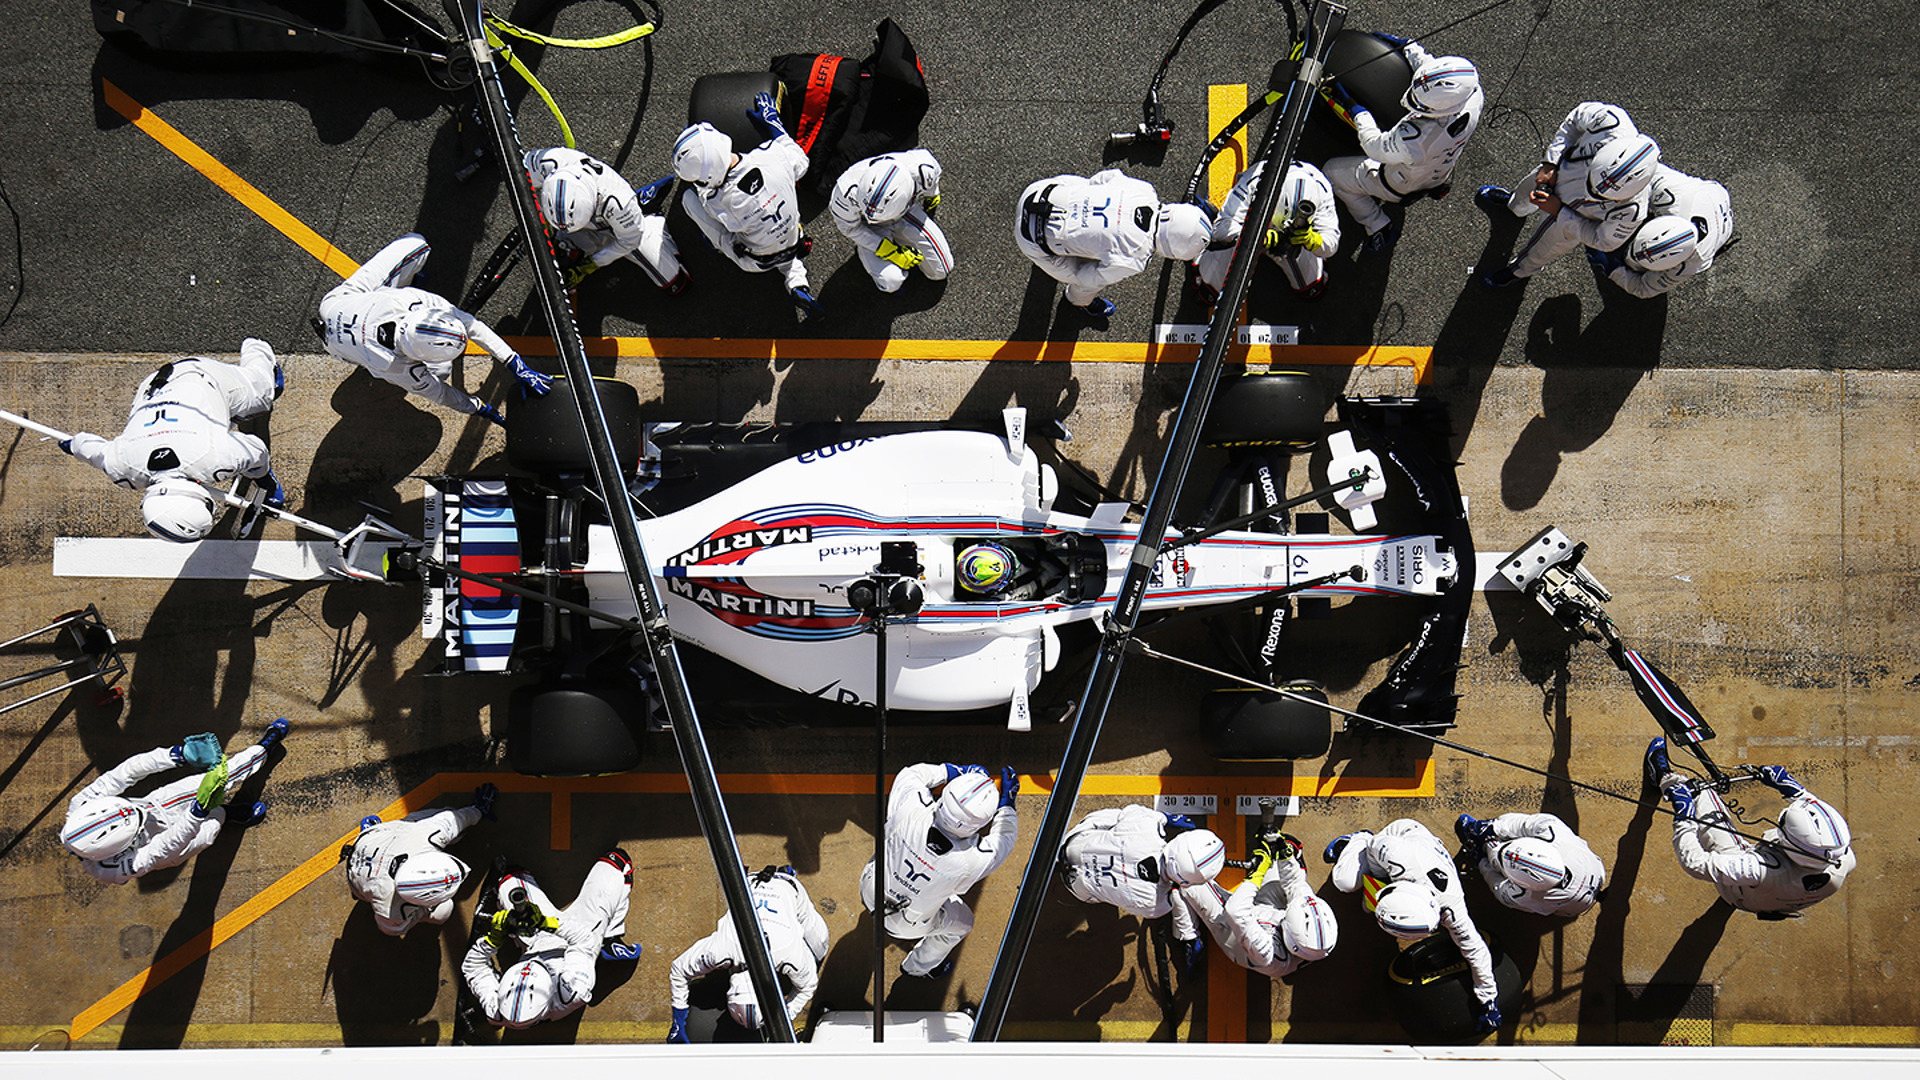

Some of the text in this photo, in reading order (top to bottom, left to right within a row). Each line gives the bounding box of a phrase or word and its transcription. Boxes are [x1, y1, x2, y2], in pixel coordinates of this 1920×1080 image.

[816, 65, 830, 88] LEFT
[669, 527, 808, 567] MARTINI
[819, 546, 880, 562] ndstad
[1177, 547, 1185, 586] MARTINI
[1293, 555, 1309, 577] 19
[1397, 545, 1405, 585] PIRELLI
[1412, 545, 1423, 585] ORIS
[445, 494, 461, 657] MARTINI
[671, 577, 811, 616] MARTINI
[1269, 607, 1285, 657] Rexona
[1164, 796, 1214, 806] 30 20 10
[1240, 796, 1251, 806] 10
